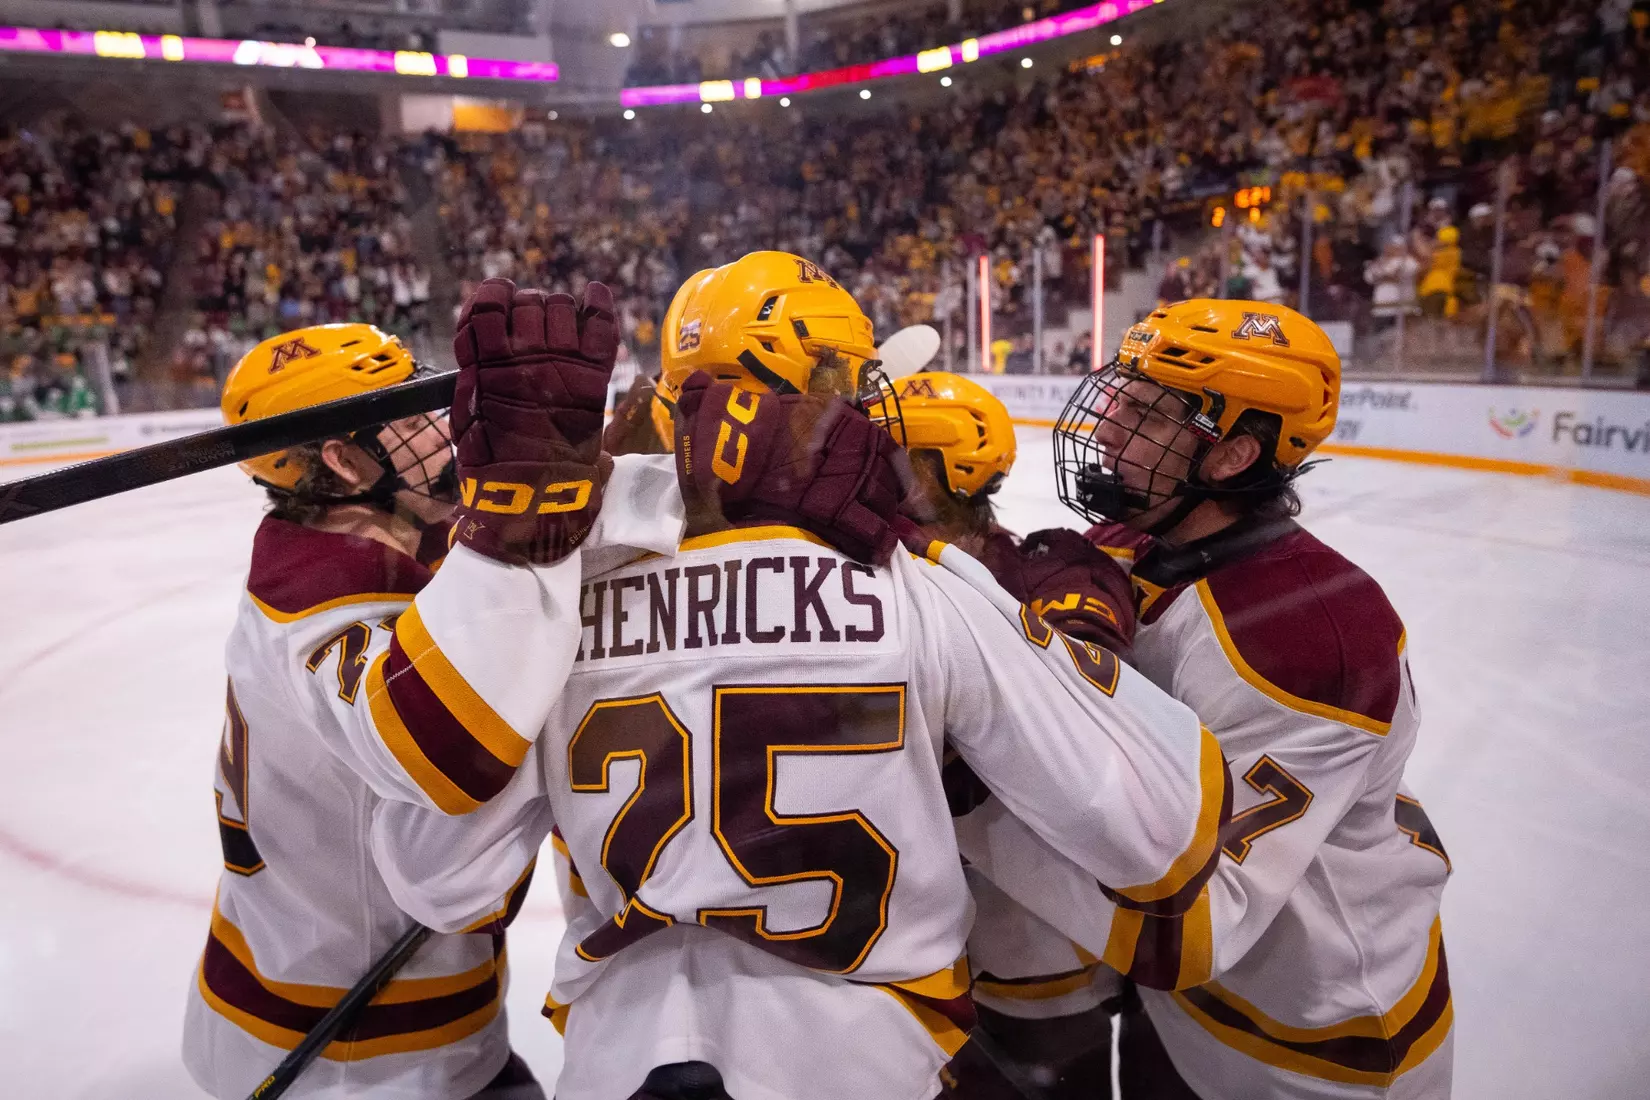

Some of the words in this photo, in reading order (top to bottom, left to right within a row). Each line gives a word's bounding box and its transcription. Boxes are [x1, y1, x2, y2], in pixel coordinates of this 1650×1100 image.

[1231, 311, 1291, 348] M
[267, 336, 322, 375] M
[900, 379, 939, 401] M
[574, 556, 885, 661] HENRICKS
[567, 682, 907, 975] 25
